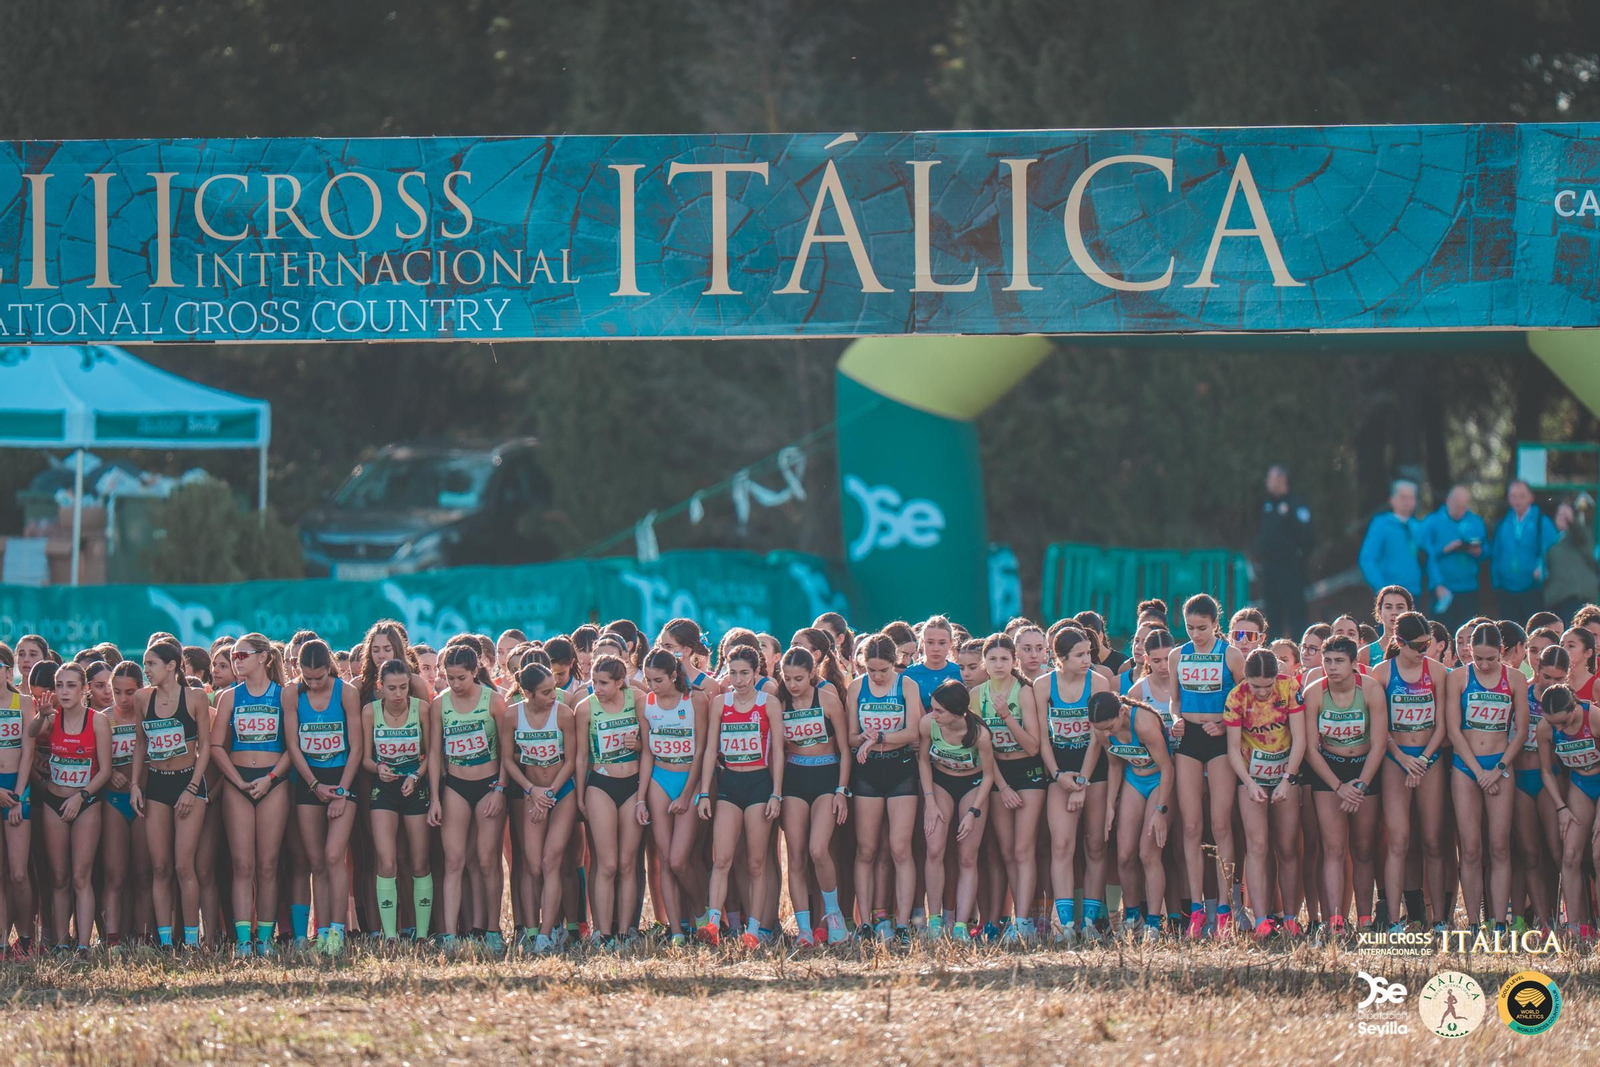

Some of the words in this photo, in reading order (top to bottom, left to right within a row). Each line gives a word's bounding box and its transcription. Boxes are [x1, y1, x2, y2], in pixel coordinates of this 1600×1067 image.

[1554, 189, 1600, 217] CA
[608, 132, 1307, 297] ITÁLICA
[0, 171, 184, 289] III
[194, 169, 474, 242] CROSS
[196, 248, 580, 288] INTERNACIONAL
[175, 299, 300, 335] CROSS
[311, 298, 512, 333] COUNTRY
[1181, 667, 1219, 682] 5412
[1395, 707, 1432, 721] 7472
[1470, 705, 1507, 721] 7471
[237, 717, 276, 732] 5458
[784, 722, 822, 739] 5469
[863, 717, 901, 731] 5397
[1054, 721, 1091, 735] 7503
[1323, 724, 1362, 739] 7445
[303, 735, 342, 751] 7509
[378, 742, 417, 756] 8344
[447, 735, 486, 754] 7513
[653, 740, 692, 754] 5398
[722, 736, 759, 752] 7416
[1561, 751, 1599, 766] 7473
[53, 768, 88, 784] 7447
